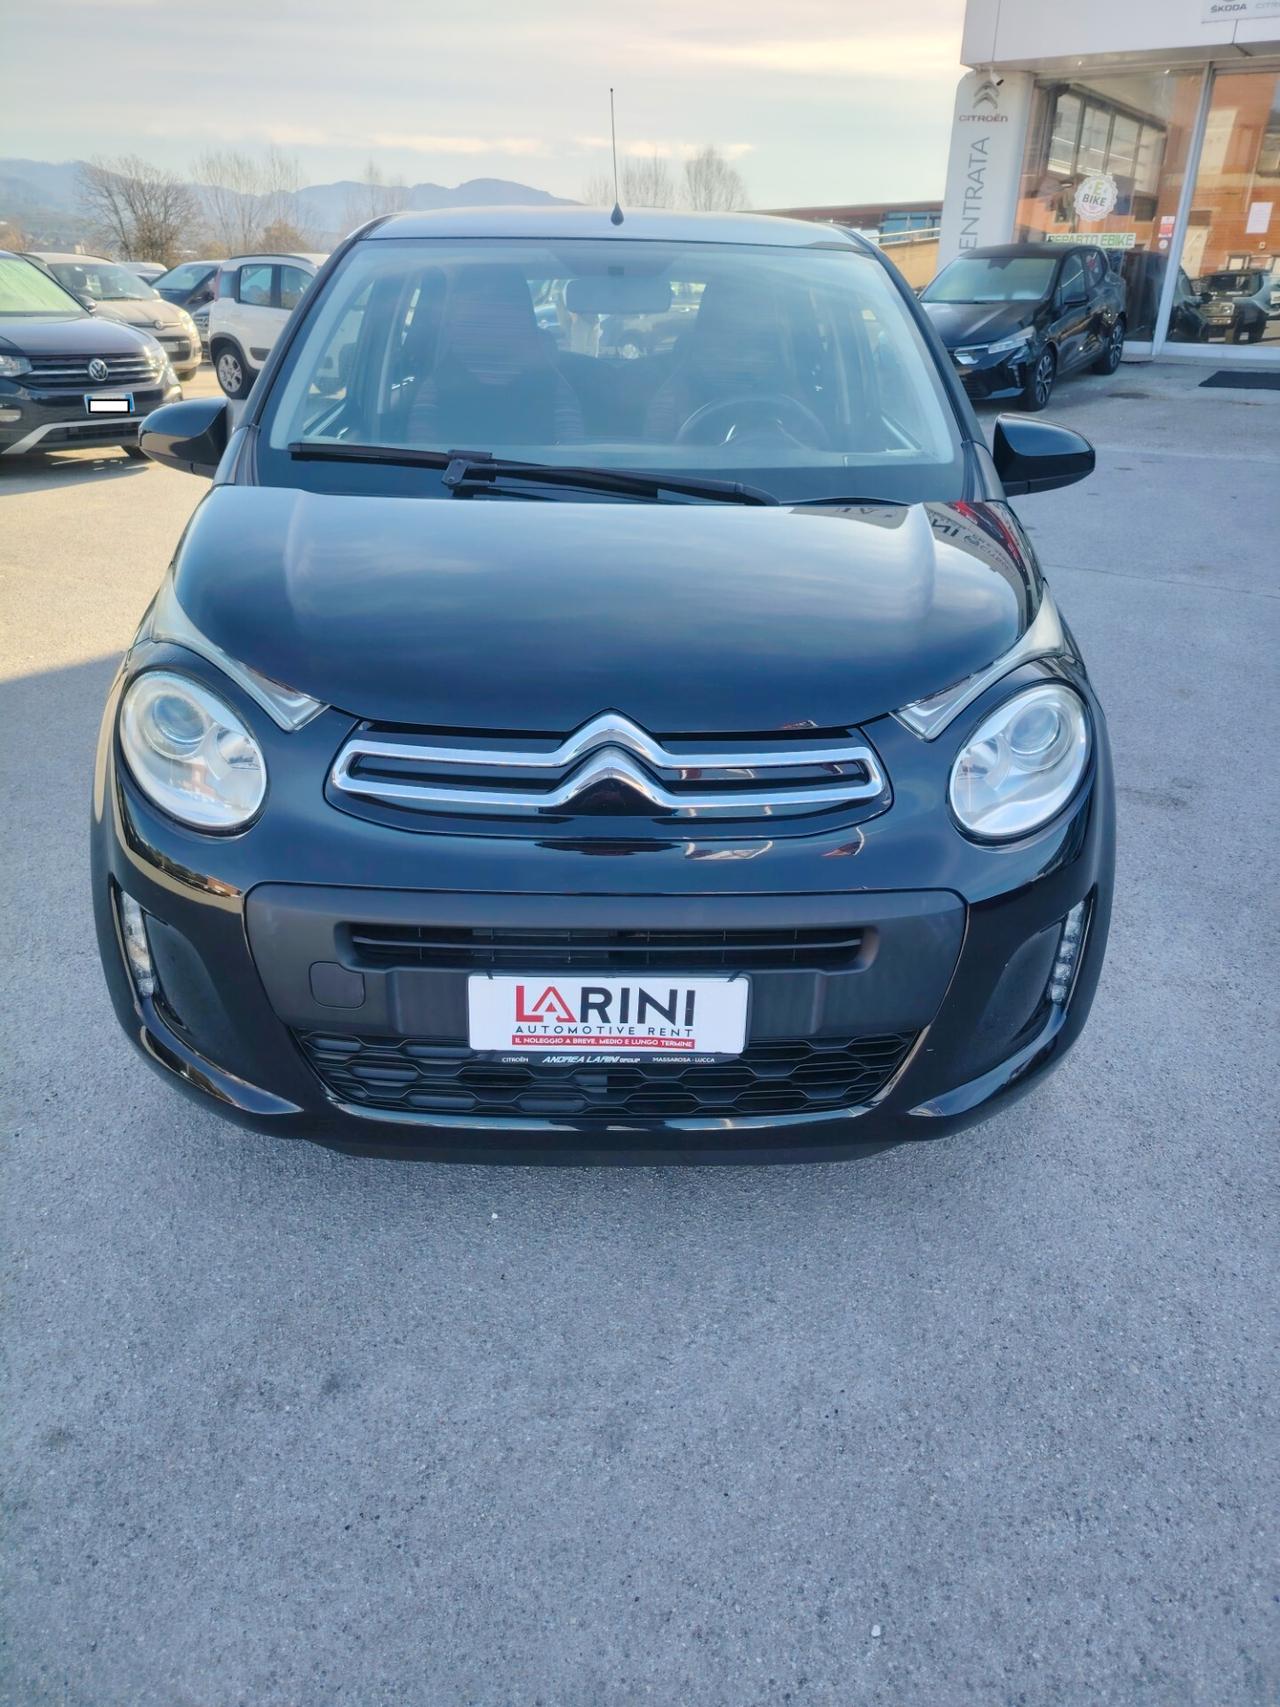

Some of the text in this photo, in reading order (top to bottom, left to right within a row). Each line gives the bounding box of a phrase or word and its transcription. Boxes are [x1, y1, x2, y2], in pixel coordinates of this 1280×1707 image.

[958, 136, 990, 250] ENTRATA
[1082, 193, 1107, 207] BIKE
[516, 985, 695, 1027] LARINI
[515, 1025, 693, 1037] AUTOMOTIVE RENT
[660, 1040, 693, 1048] TERMINE
